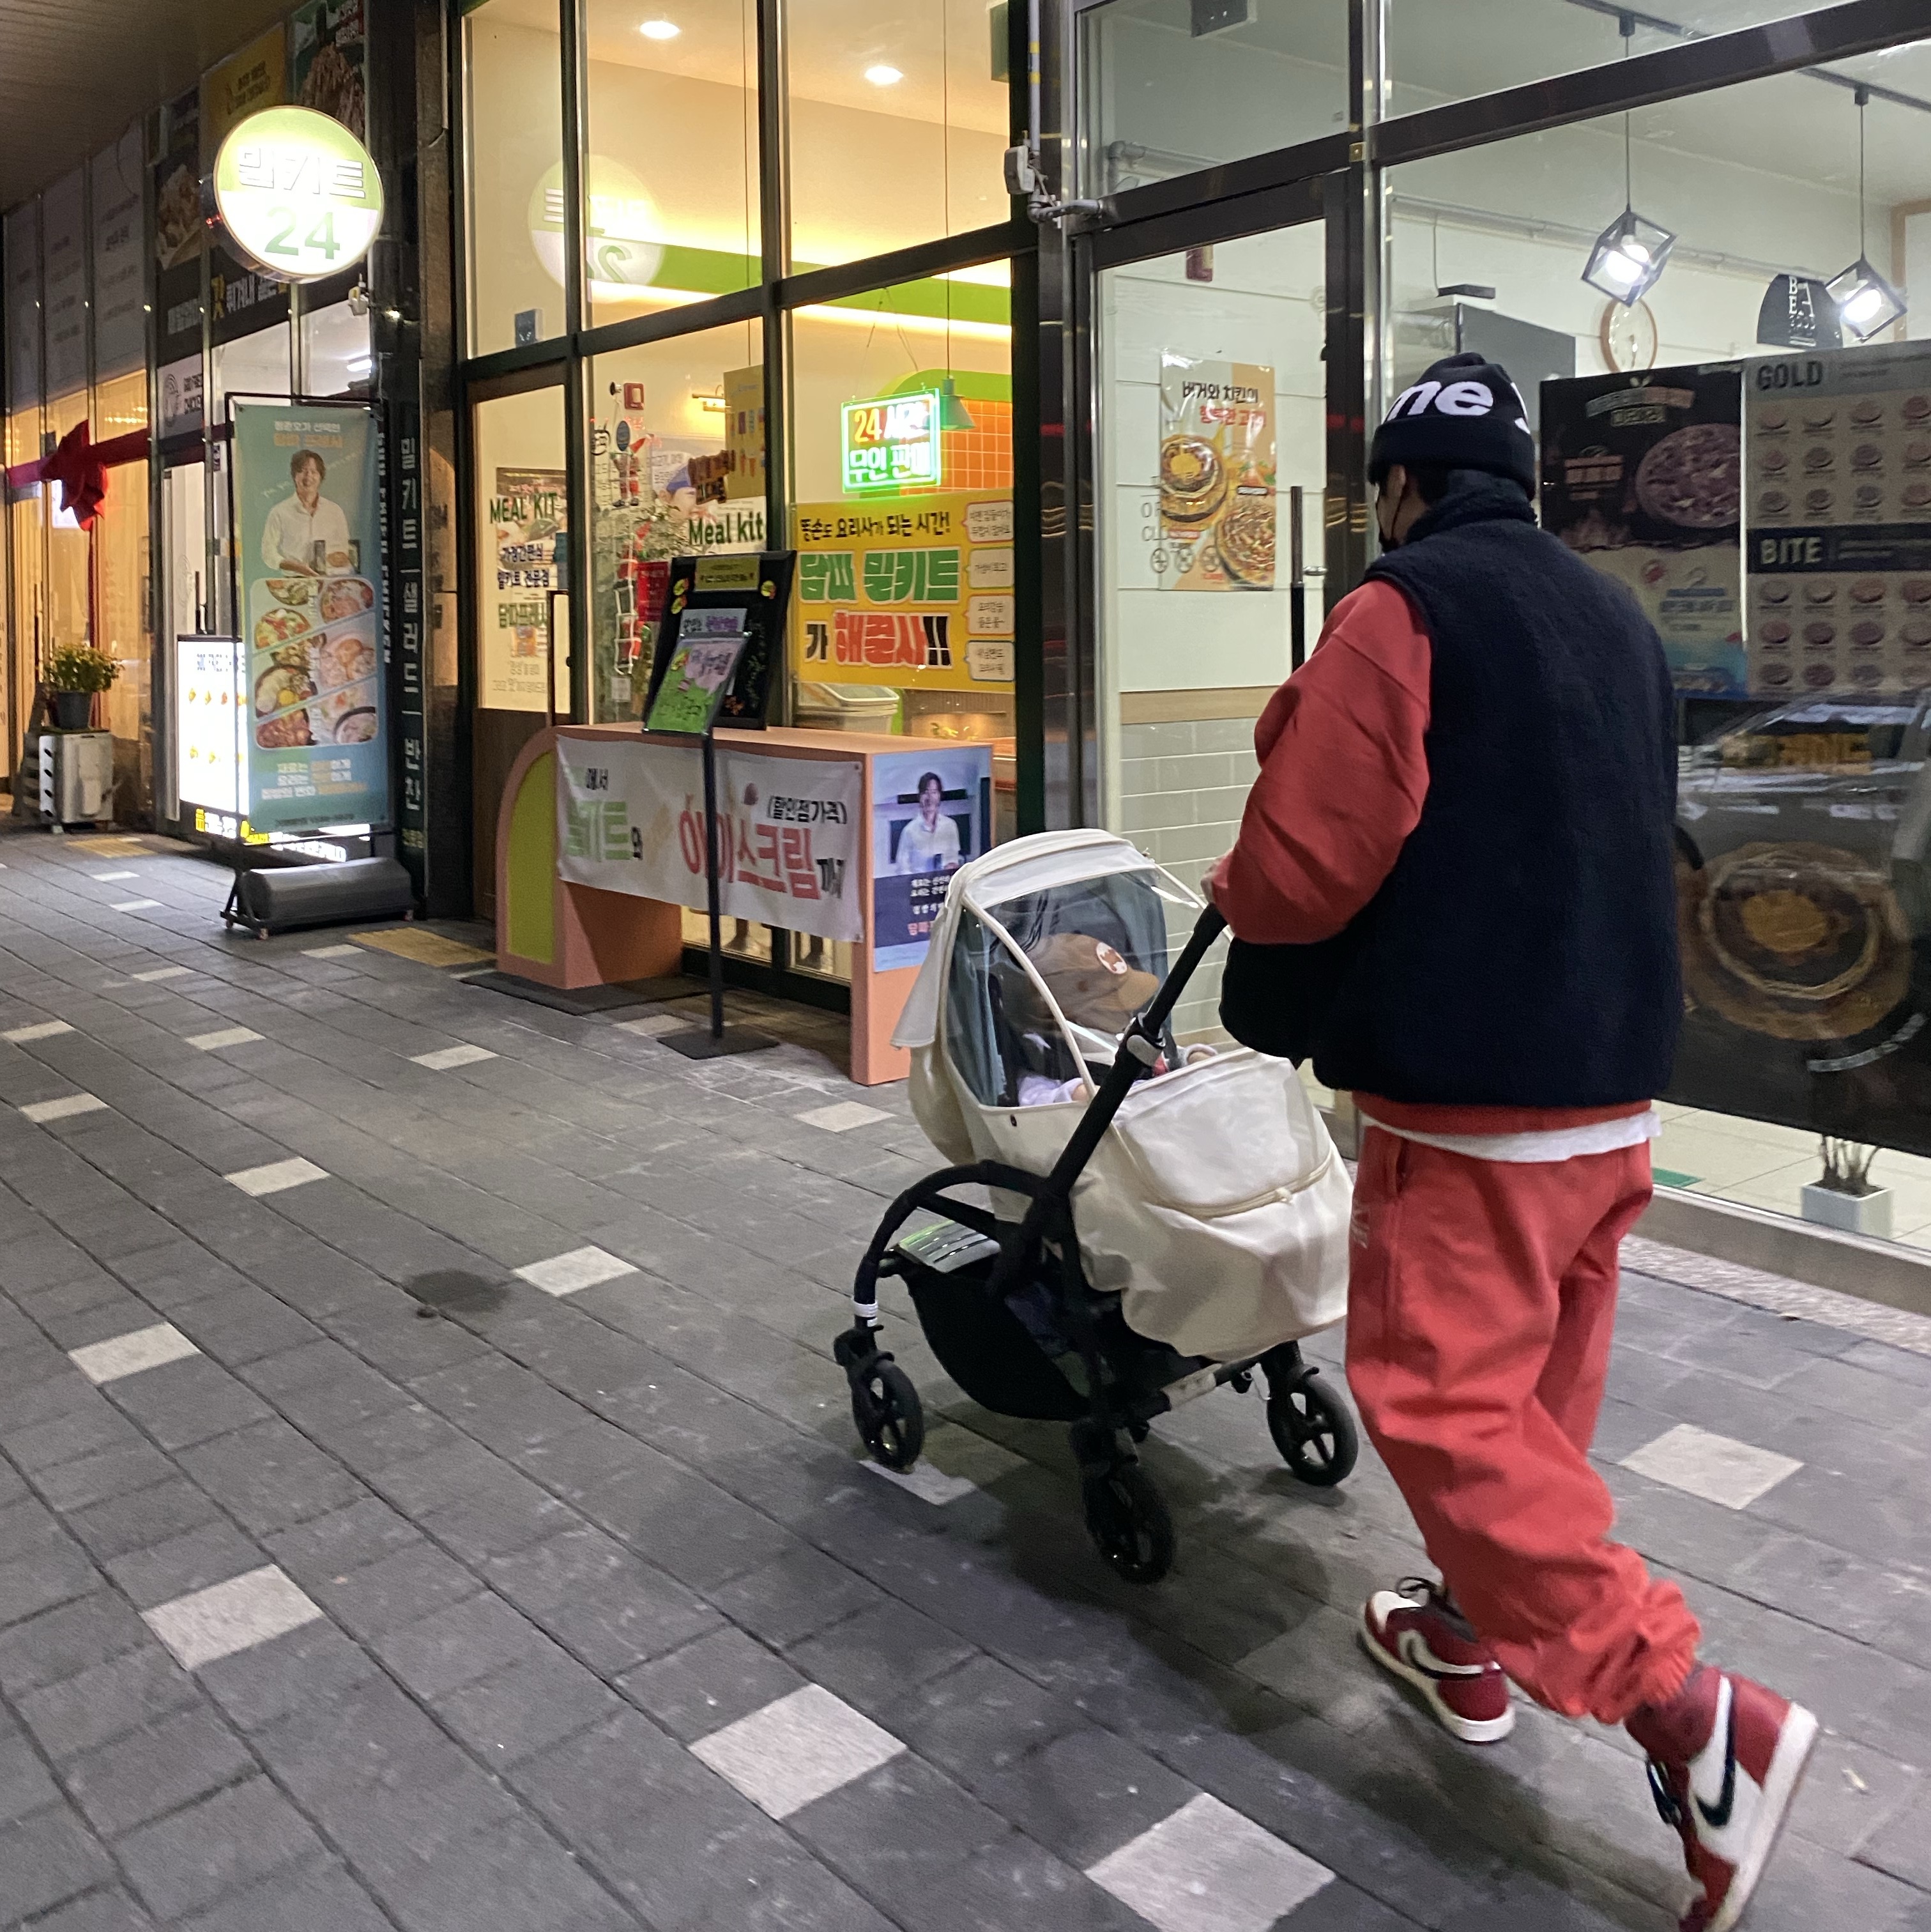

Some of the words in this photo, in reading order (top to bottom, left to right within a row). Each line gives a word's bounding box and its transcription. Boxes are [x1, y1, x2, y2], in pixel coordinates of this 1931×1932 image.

[238, 147, 366, 199] 밀키트
[264, 206, 340, 259] 24
[1757, 360, 1823, 391] GOLD
[850, 447, 888, 482] 무인
[400, 437, 418, 549] 밀키트
[490, 497, 527, 524] MEAL
[534, 492, 557, 519] KIT
[689, 513, 731, 544] Meal
[738, 511, 764, 540] kit
[834, 516, 883, 538] 요리사가
[887, 514, 912, 537] 되는
[917, 511, 950, 536] 시간!
[1760, 537, 1822, 564] BITE
[864, 550, 959, 602] 밀키트
[806, 623, 828, 660] 가
